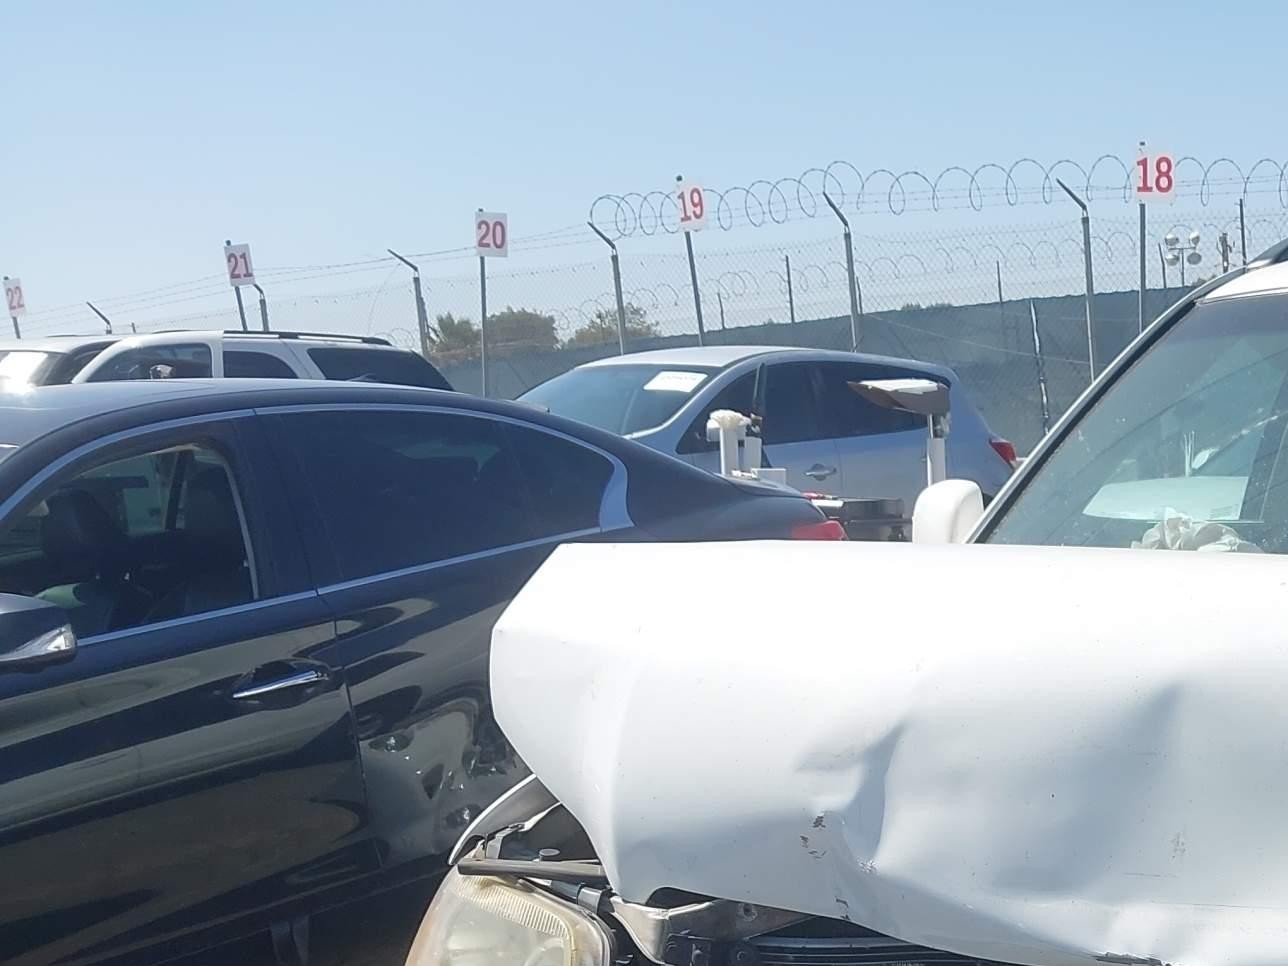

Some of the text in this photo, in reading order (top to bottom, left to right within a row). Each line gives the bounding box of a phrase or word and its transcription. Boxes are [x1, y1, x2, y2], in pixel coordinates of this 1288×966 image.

[1136, 156, 1173, 193] 18
[677, 187, 705, 223] 19
[477, 220, 506, 249] 20
[228, 252, 254, 279] 21
[6, 286, 25, 310] 22
